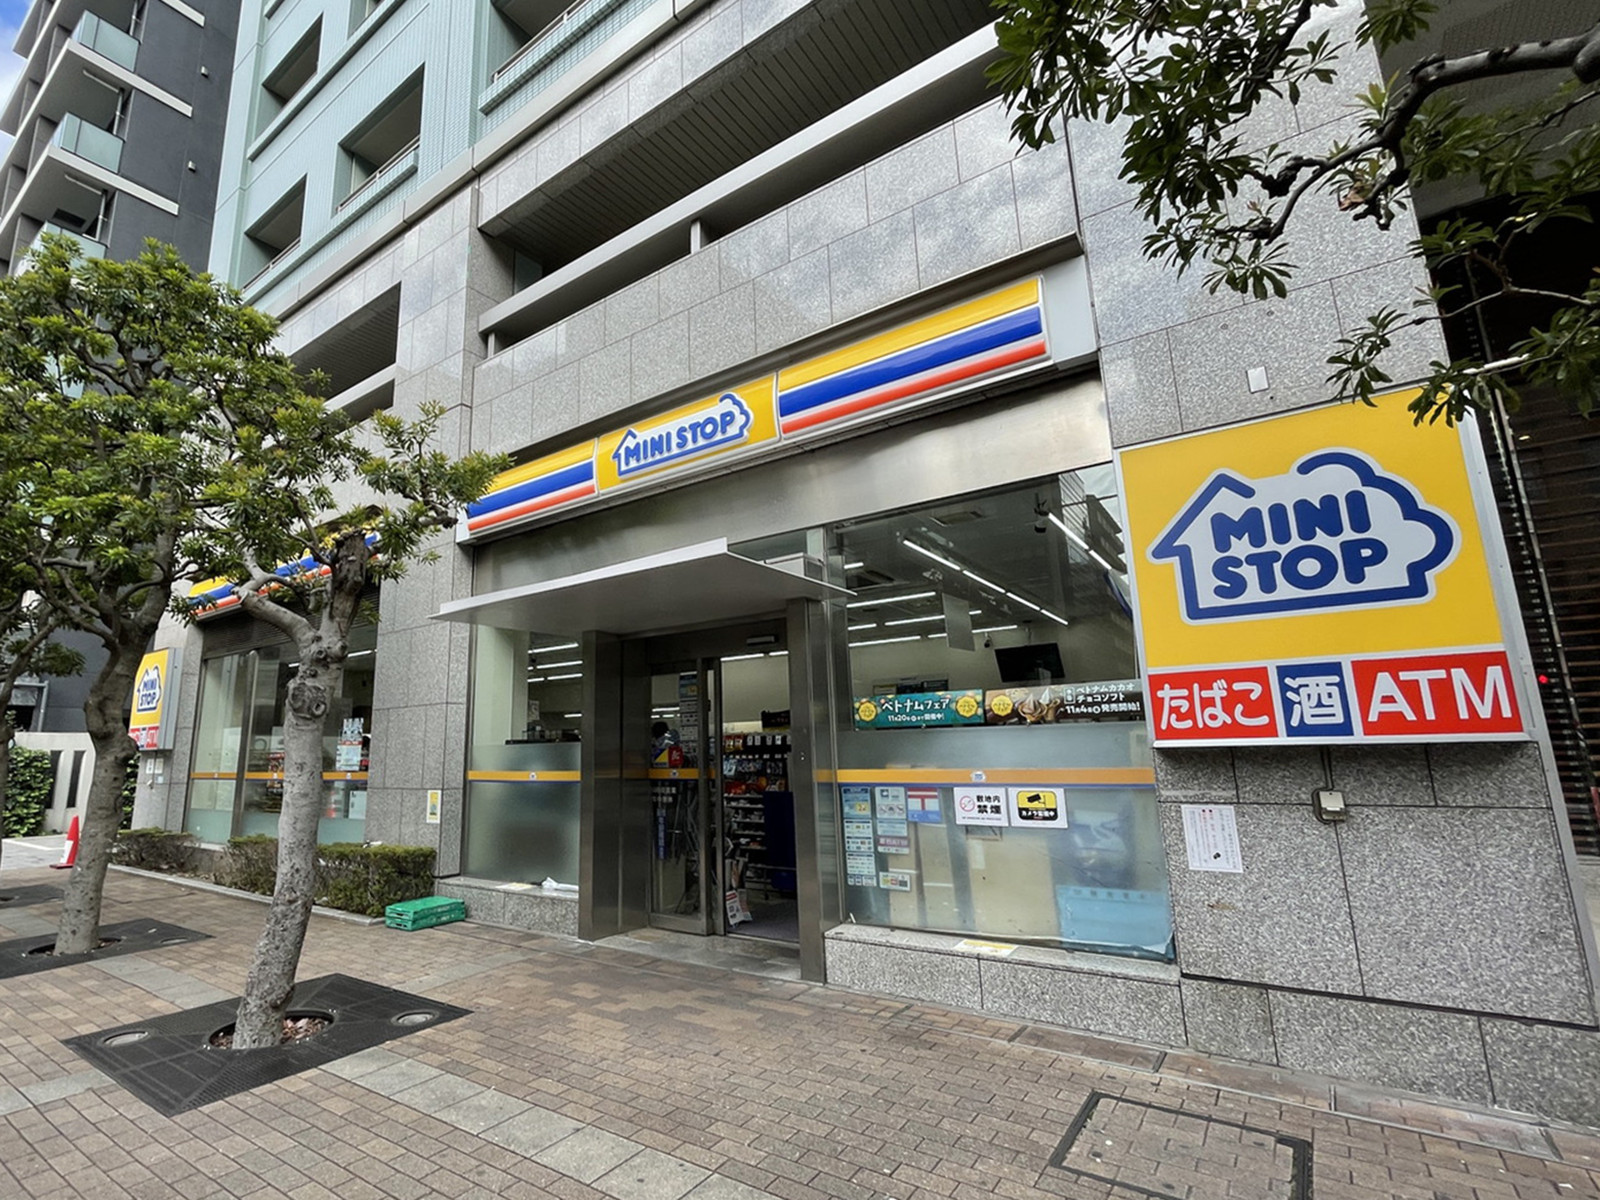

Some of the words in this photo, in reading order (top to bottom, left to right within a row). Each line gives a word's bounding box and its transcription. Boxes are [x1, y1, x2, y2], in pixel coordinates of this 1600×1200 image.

[624, 431, 672, 466] MINI
[676, 410, 736, 449] STOP
[1210, 490, 1372, 553] MINI
[1211, 537, 1389, 600] STOP
[1076, 682, 1135, 694] ベトナムカカオ
[140, 691, 157, 707] STOP
[882, 698, 950, 713] ベトナムフェア
[1076, 692, 1126, 704] チョコソフト
[1156, 678, 1270, 731] たばこ
[1283, 675, 1345, 728] 酒
[1367, 664, 1514, 723] ATM
[977, 804, 1002, 815] 禁煙
